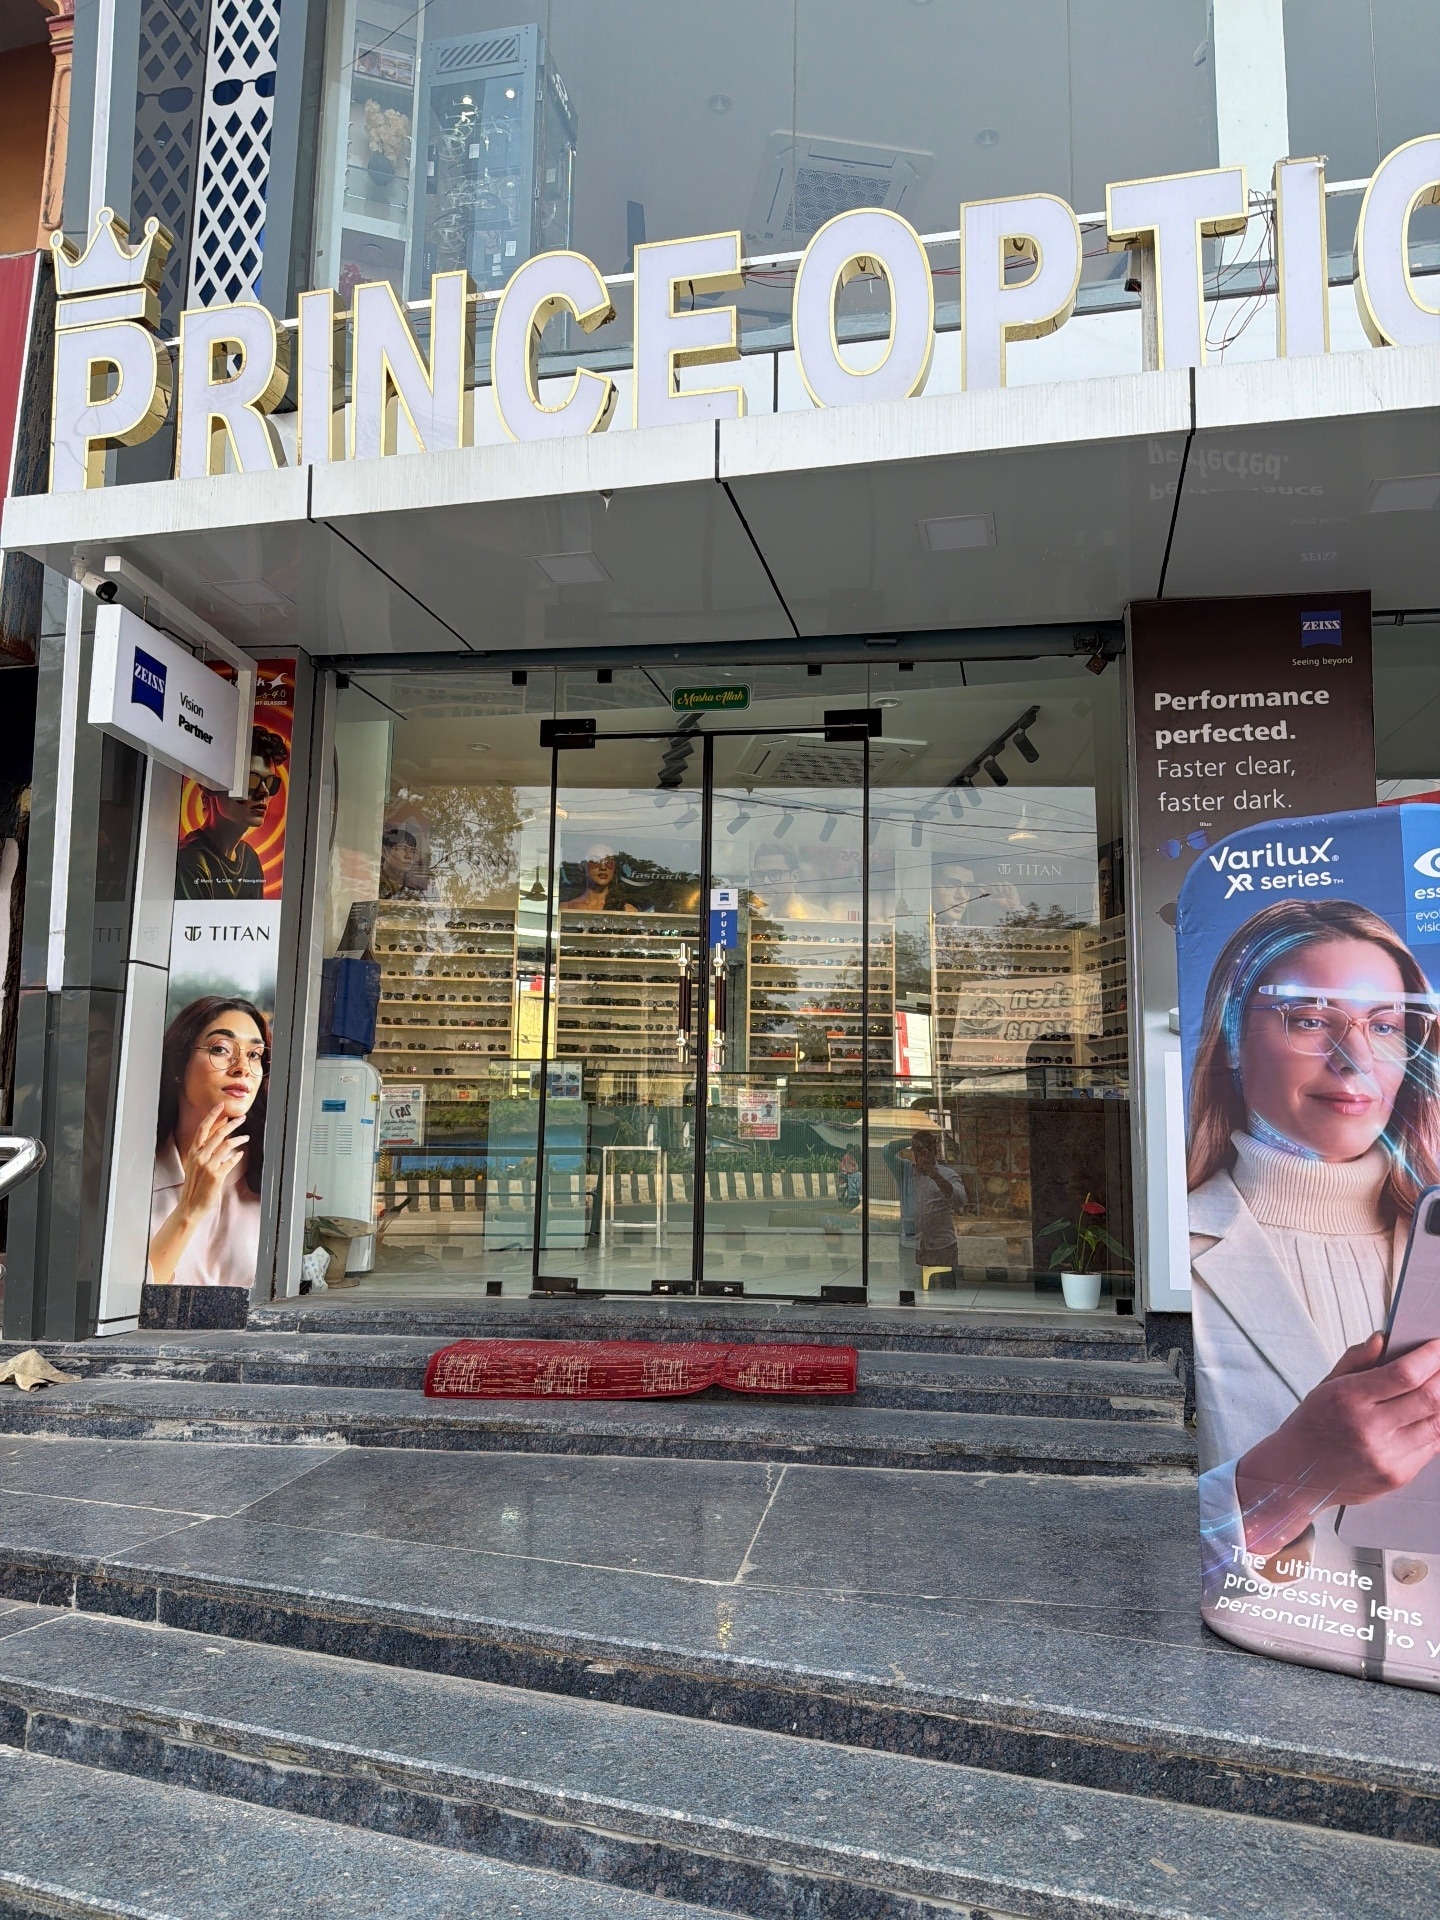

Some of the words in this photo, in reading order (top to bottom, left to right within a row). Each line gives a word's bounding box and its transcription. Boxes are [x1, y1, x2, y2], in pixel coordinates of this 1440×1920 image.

[50, 231, 745, 494] PRINCE
[1302, 620, 1341, 631] ZEISS
[1292, 657, 1320, 667] Seeing
[1322, 656, 1353, 667] beyond
[134, 662, 165, 694] ZEISS
[180, 691, 204, 719] Vision
[677, 692, 714, 708] Masha
[715, 690, 744, 706] Allah
[1154, 689, 1330, 711] Performance
[178, 713, 214, 745] Partner
[1155, 720, 1296, 749] perfected.
[1157, 759, 1227, 778] Faster
[1235, 755, 1296, 777] clear,
[1158, 791, 1225, 812] faster
[1233, 788, 1293, 810] dark.
[630, 870, 682, 881] fastrack
[1016, 864, 1062, 877] TITAN
[1223, 873, 1255, 900] XR
[208, 925, 270, 941] TITAN
[720, 911, 728, 946] PUSH
[1231, 1544, 1267, 1571] The
[1275, 1558, 1373, 1591] ultimate
[1223, 1572, 1358, 1614] progressive
[1370, 1599, 1423, 1627] lens
[1215, 1595, 1374, 1641] personalized
[1386, 1628, 1415, 1649] to
